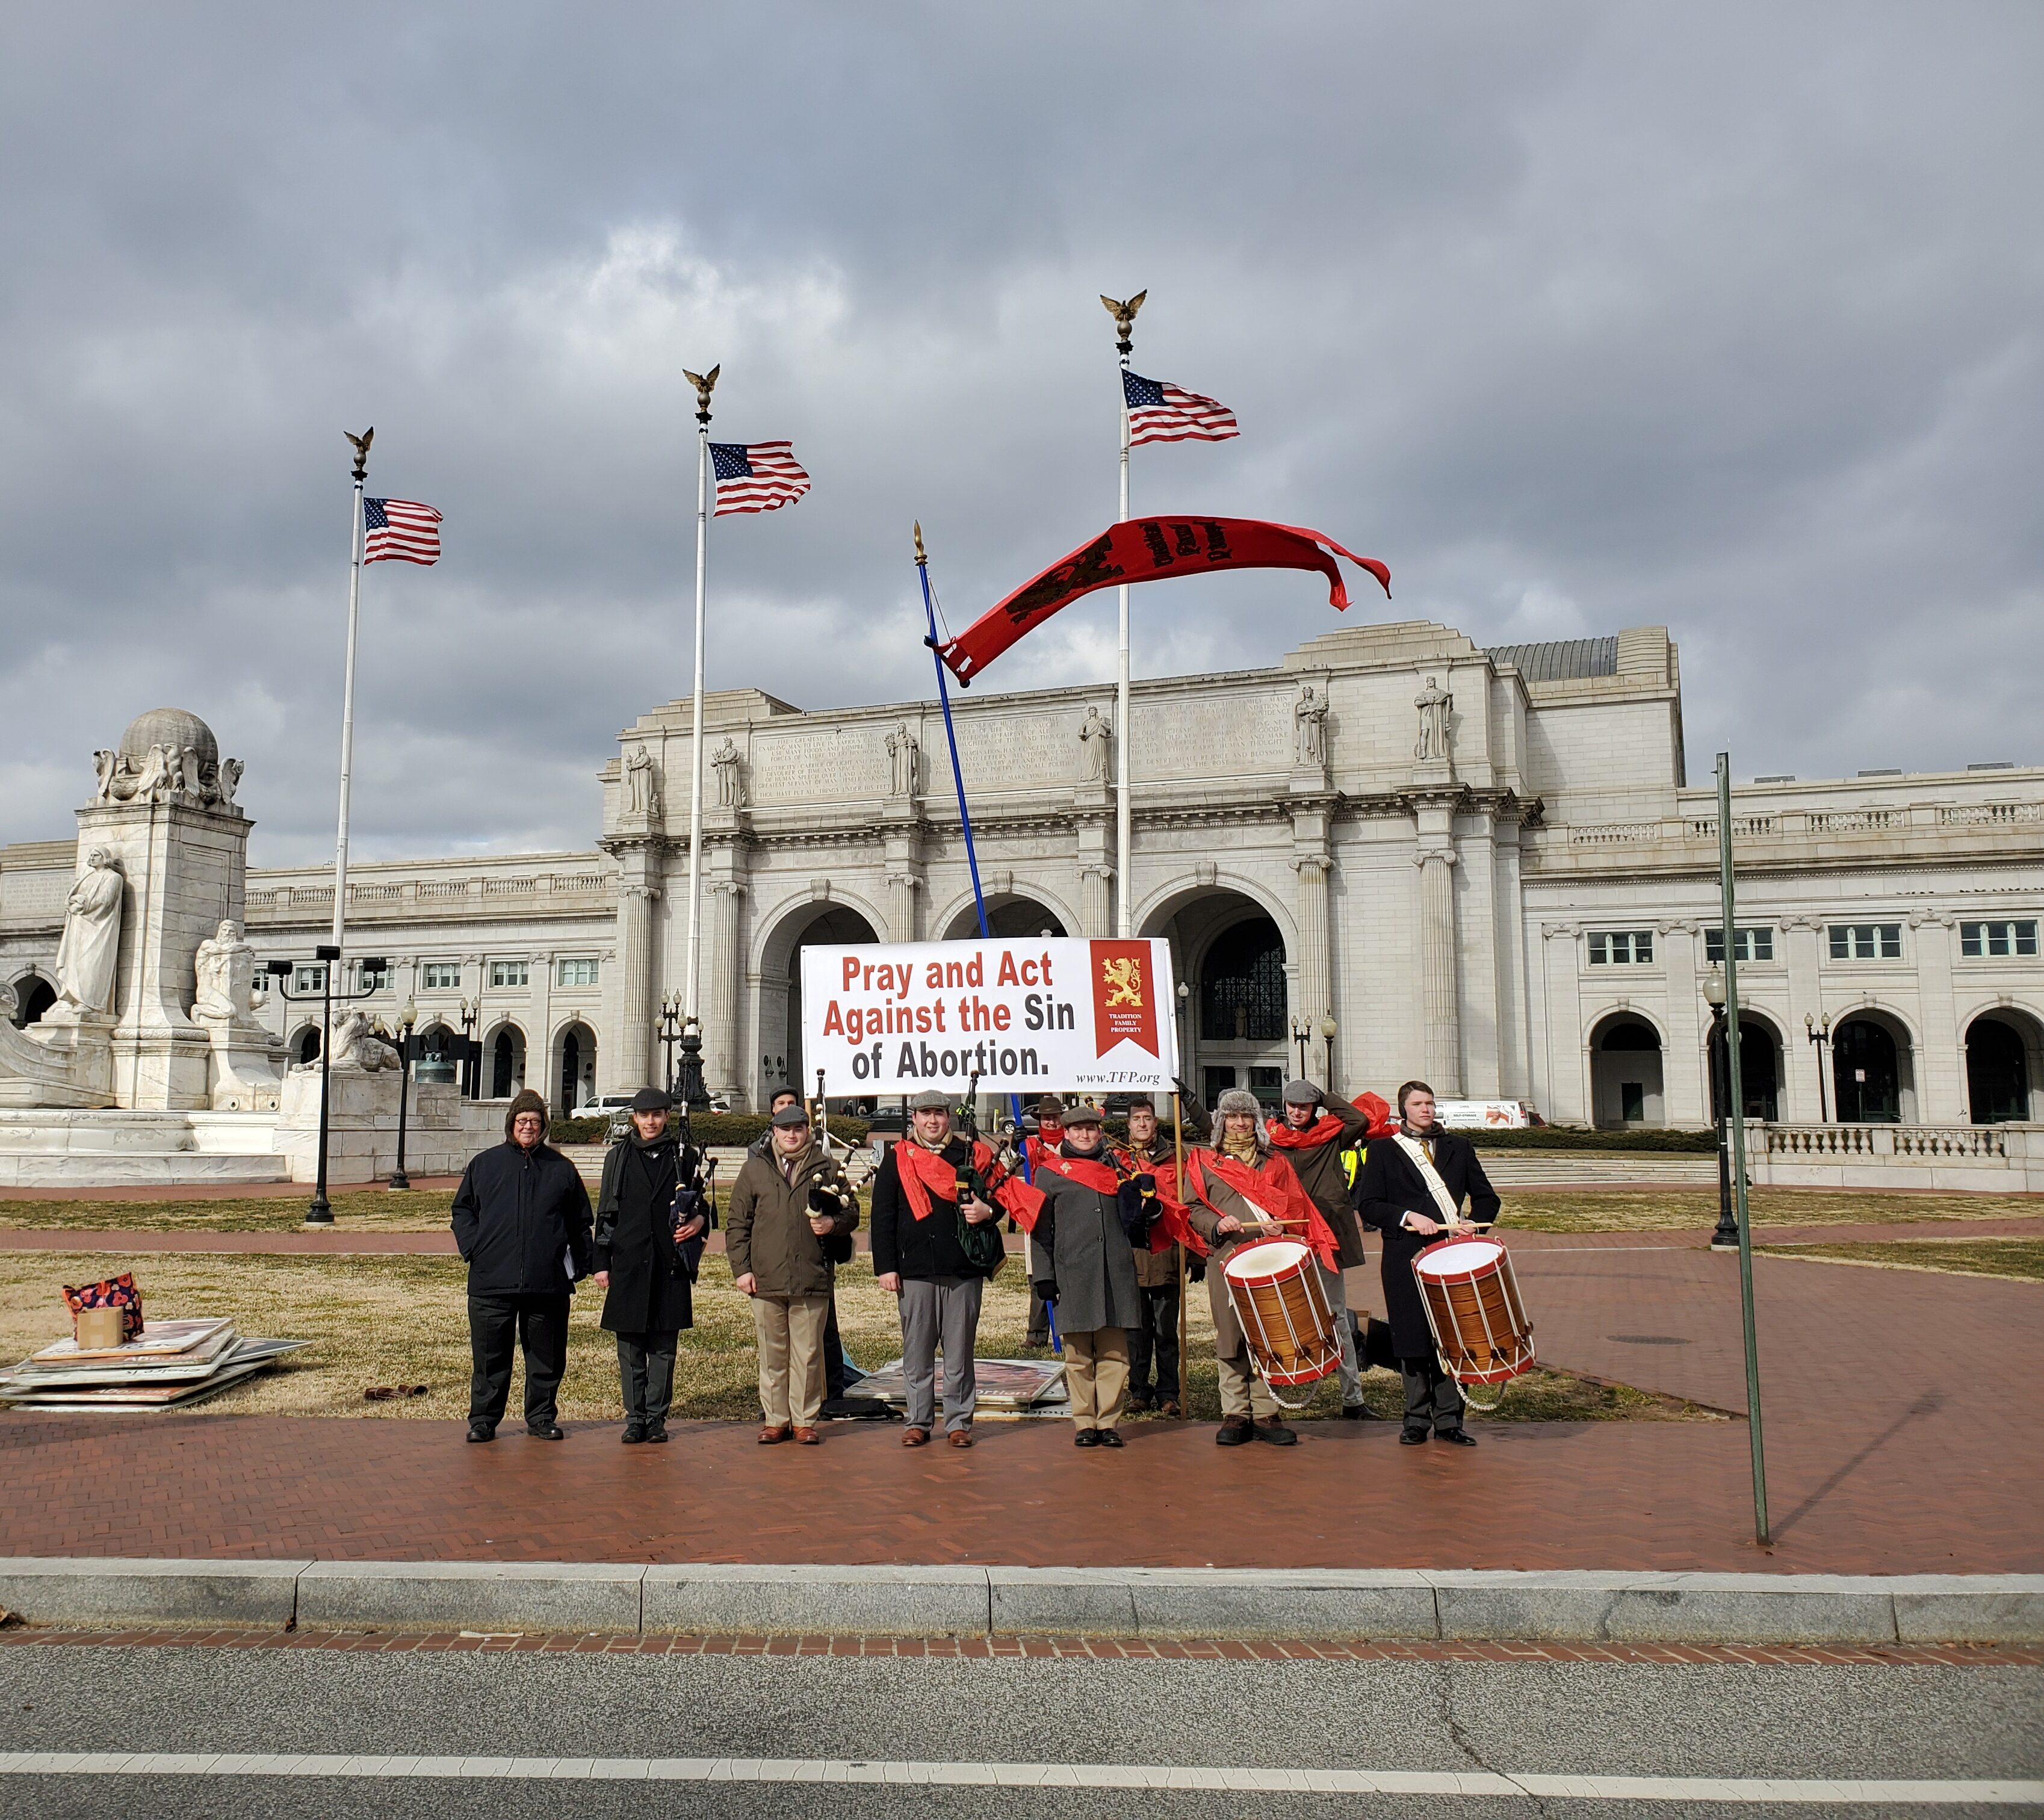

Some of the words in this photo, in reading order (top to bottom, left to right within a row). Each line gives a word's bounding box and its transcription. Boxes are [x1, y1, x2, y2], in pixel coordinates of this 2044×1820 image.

[843, 957, 912, 999] Pray
[927, 952, 983, 988] and
[998, 952, 1052, 986] Act
[823, 998, 945, 1045] Against
[959, 996, 1011, 1031] the
[1025, 994, 1074, 1030] Sin
[852, 1042, 882, 1079] of
[897, 1040, 1048, 1078] Abortion.
[1076, 1071, 1160, 1086] www.TFP.org
